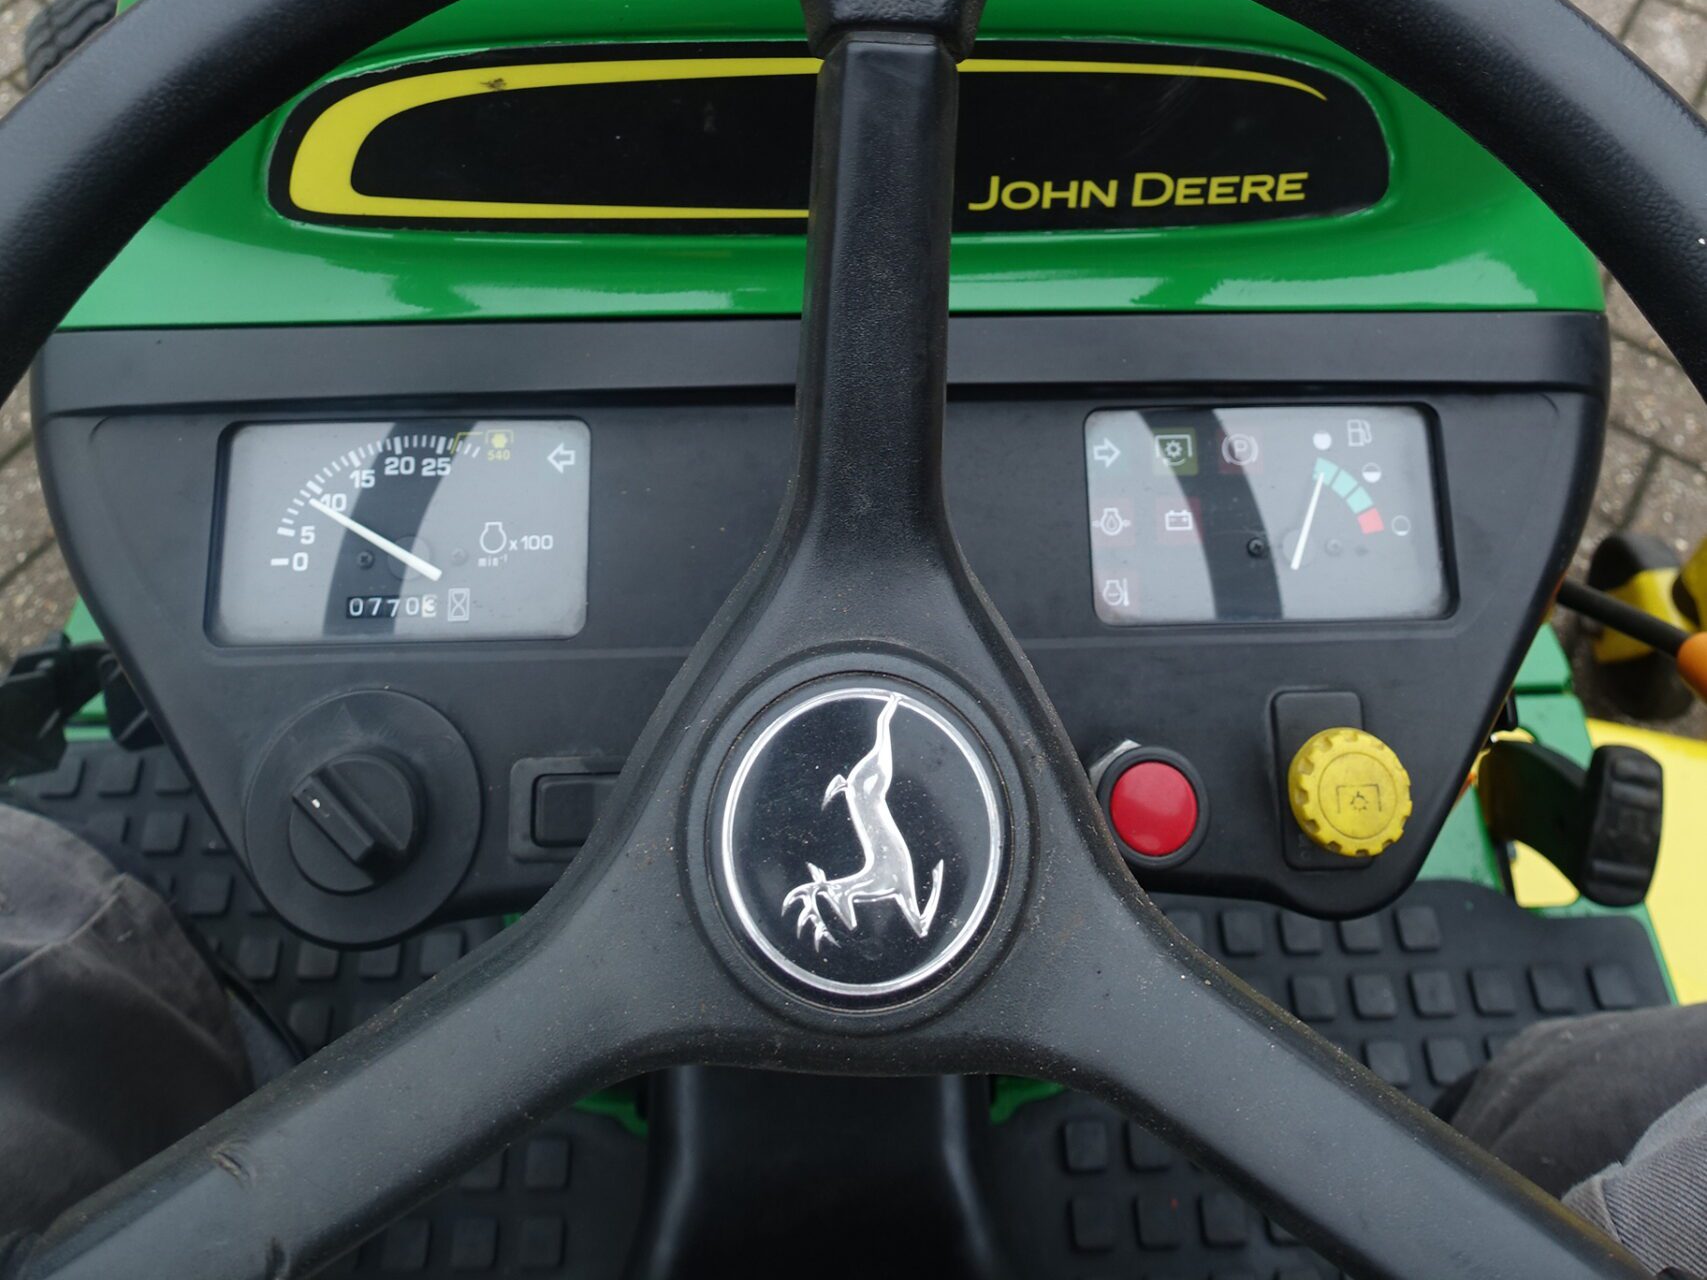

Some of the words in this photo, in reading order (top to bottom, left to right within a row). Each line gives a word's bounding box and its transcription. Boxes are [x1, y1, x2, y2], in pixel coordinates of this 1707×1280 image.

[968, 175, 1118, 211] JOHN
[1131, 172, 1309, 207] DEERE
[487, 449, 511, 461] 540
[384, 456, 415, 476] 20
[421, 457, 451, 476] 25
[349, 469, 376, 488] 15
[320, 493, 347, 512] 10
[300, 526, 316, 544] 5
[292, 552, 309, 571] 0
